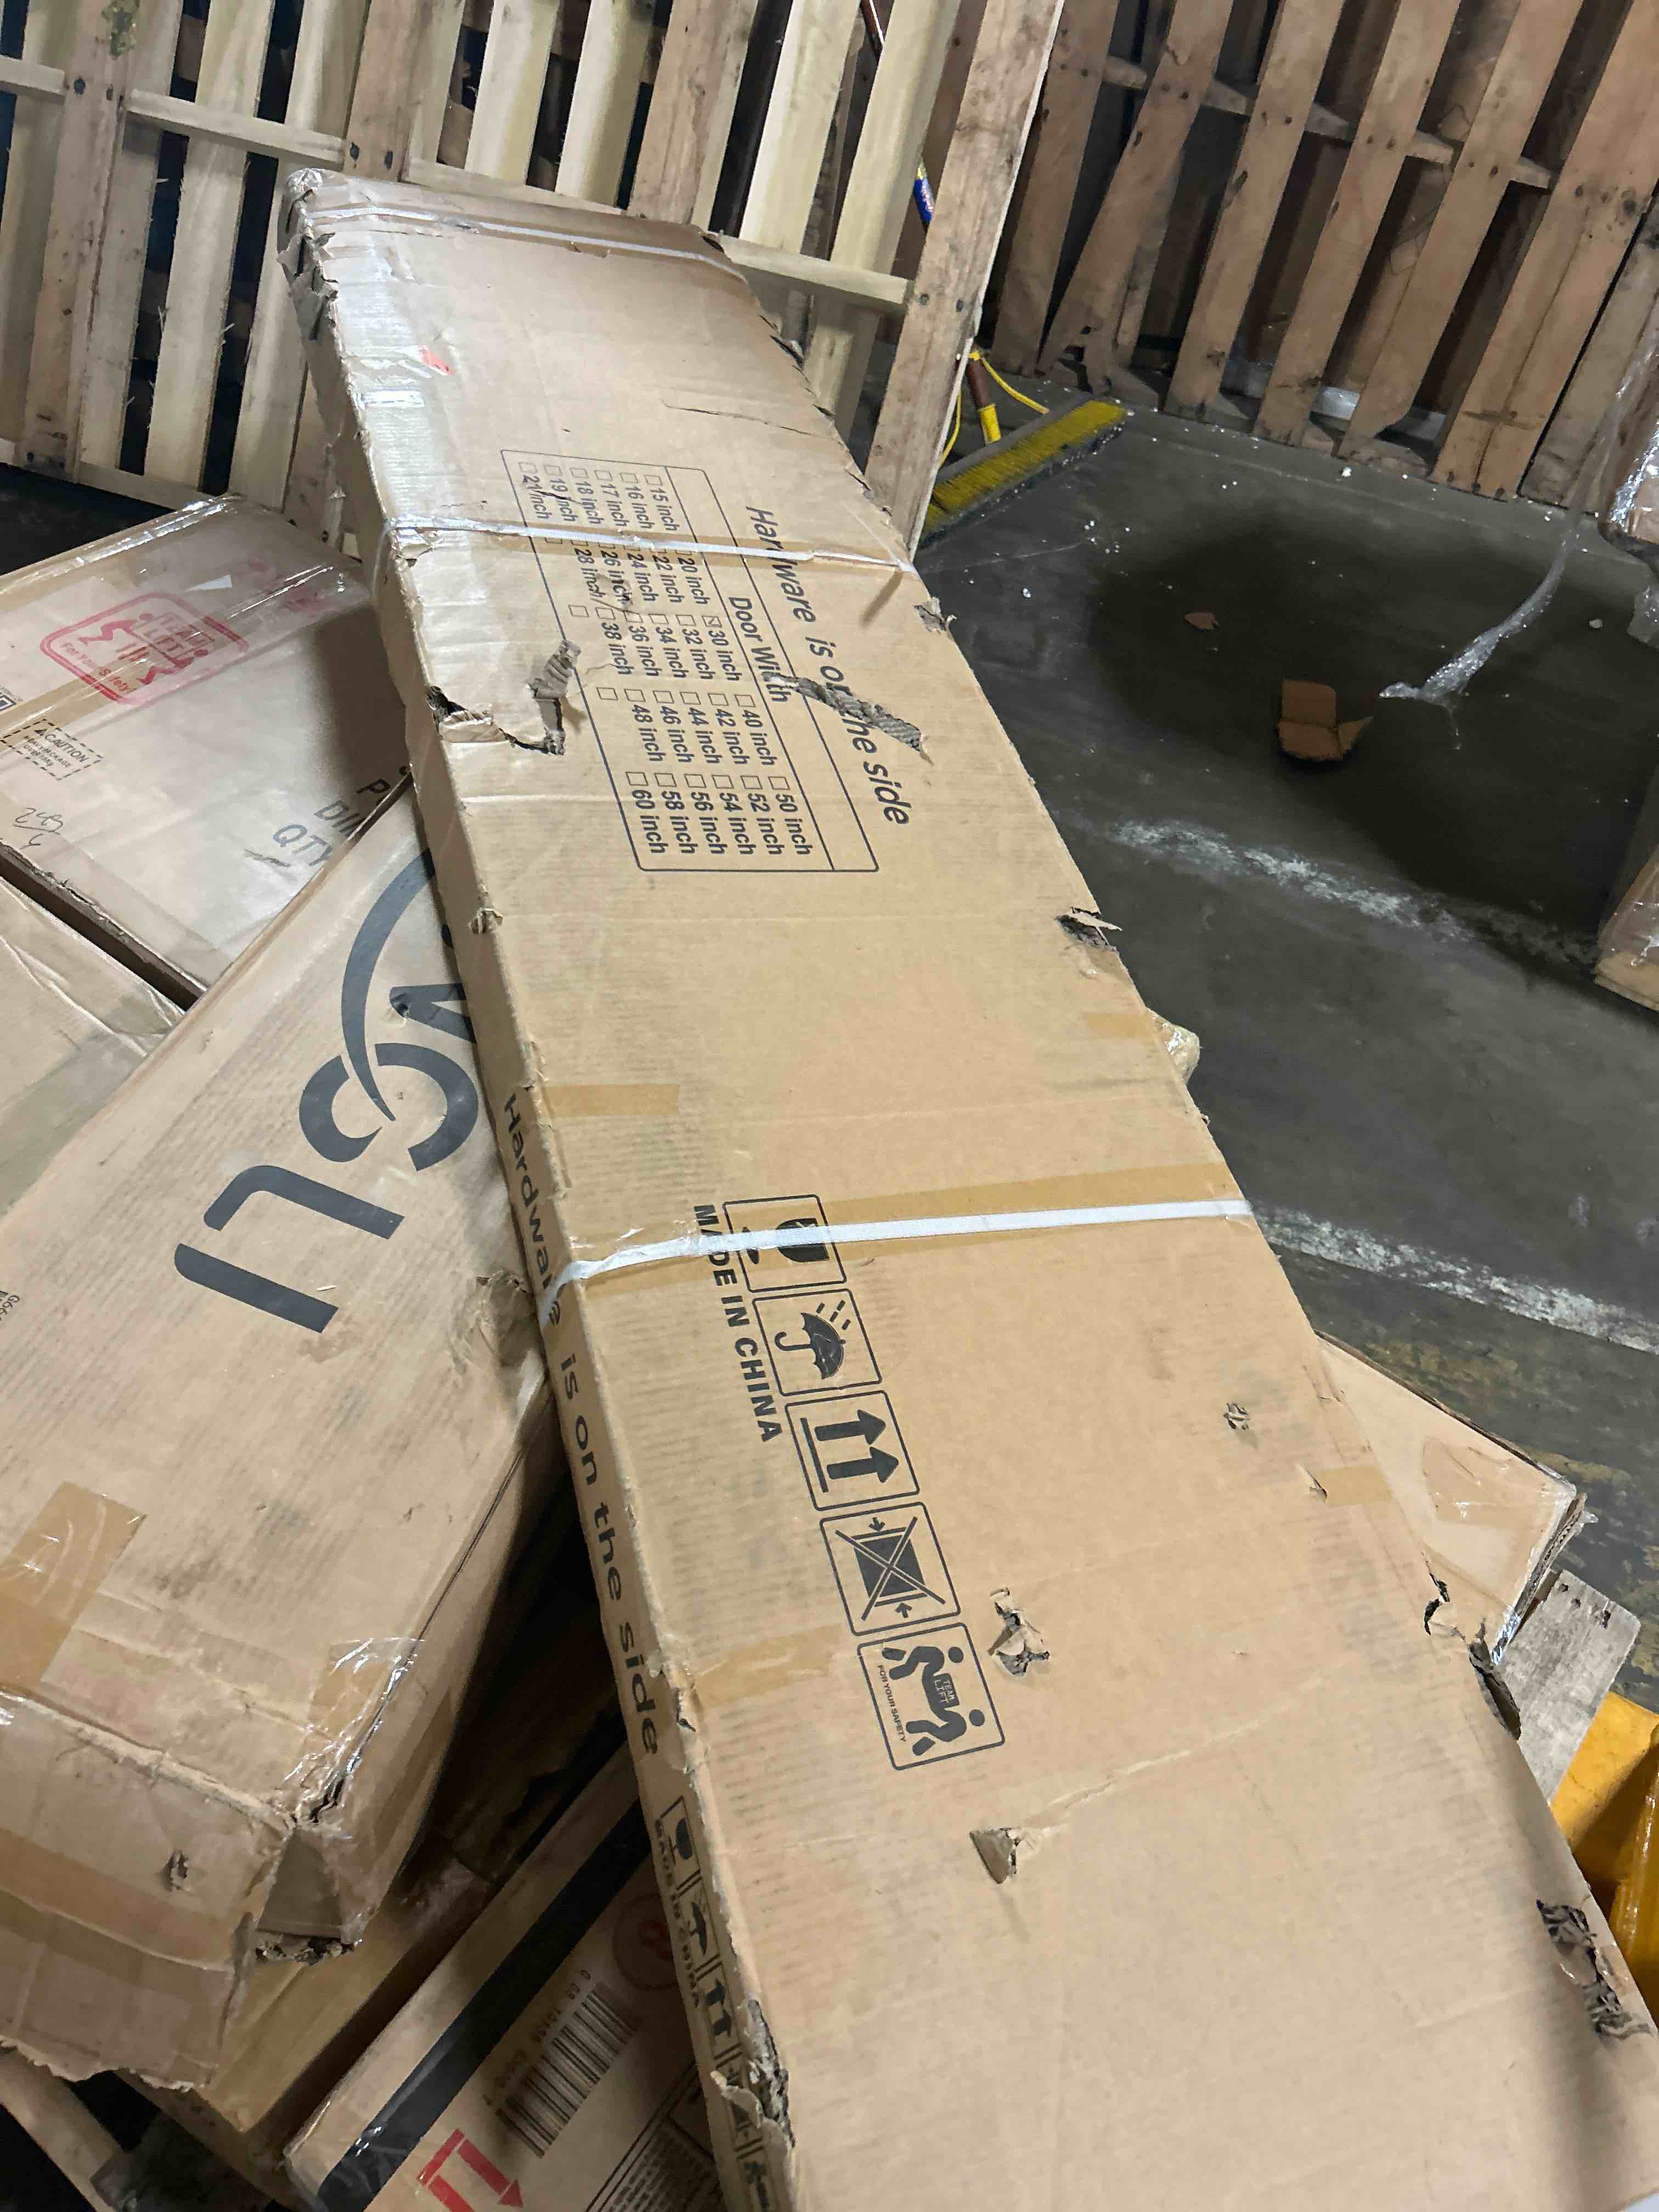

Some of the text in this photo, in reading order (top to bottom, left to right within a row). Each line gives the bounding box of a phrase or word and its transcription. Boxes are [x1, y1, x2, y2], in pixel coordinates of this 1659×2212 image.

[529, 493, 552, 518] inch
[550, 479, 567, 492] 19
[575, 482, 604, 523] 18 inch
[602, 484, 630, 526] 17 inch
[625, 486, 655, 529] 16 inch
[650, 488, 680, 531] 15 inch
[575, 549, 606, 597] 28 inch
[600, 550, 621, 566] 26
[627, 552, 658, 602] 24 inch
[653, 555, 684, 603] 22 inch
[678, 557, 710, 604] 20 inch
[729, 597, 763, 642] Door
[602, 622, 634, 675] 38 inch
[629, 626, 661, 676] 36 inch
[656, 627, 688, 678] 34 inch
[682, 629, 715, 680] 32 inch
[708, 629, 742, 681] 30 inch
[44, 734, 89, 763] CAUTION
[631, 704, 667, 762] 48 inch
[659, 707, 695, 763] 46 inch
[687, 707, 723, 764] 44 inch
[715, 709, 750, 764] 42 inch
[742, 709, 777, 765] 40 inch
[805, 636, 836, 658] is
[839, 710, 878, 753] he
[863, 764, 912, 825] side
[273, 825, 332, 866] QTY
[632, 790, 668, 854] 60 inch
[662, 791, 698, 855] 58 inch
[691, 792, 728, 855] 56 inch
[720, 793, 757, 855] 54 inch
[748, 794, 785, 855] 52 inch
[776, 794, 813, 855] 50 inch
[694, 1205, 782, 1442] MDE IN CHINA
[562, 1353, 578, 1399] is
[576, 1415, 597, 1485] on
[594, 1503, 621, 1600] the
[619, 1622, 658, 1754] side
[878, 1664, 906, 1742] FOR YOUR SAFETY
[934, 1679, 949, 1703] LIFT
